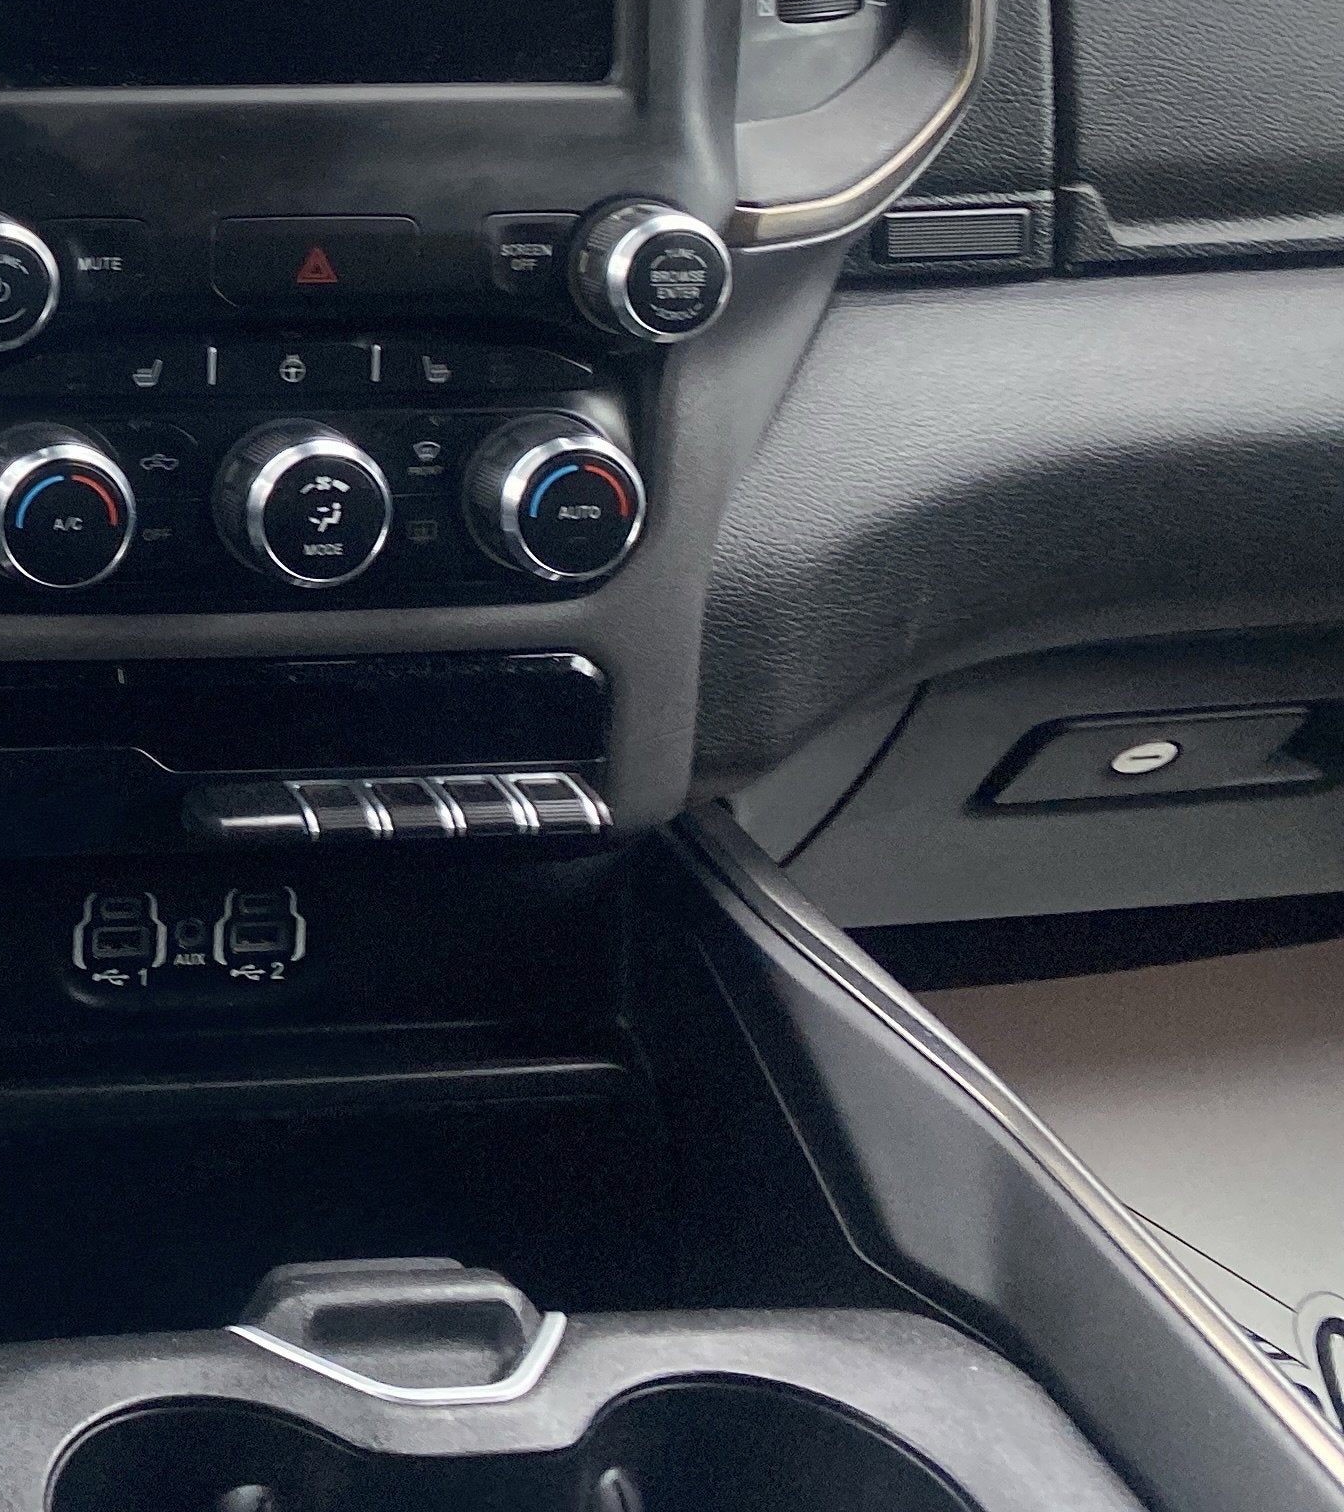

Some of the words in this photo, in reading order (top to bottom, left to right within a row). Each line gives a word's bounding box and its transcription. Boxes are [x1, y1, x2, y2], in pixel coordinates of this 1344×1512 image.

[500, 243, 553, 257] SCREEN
[77, 256, 124, 271] MUTE
[511, 258, 538, 271] OFF
[650, 269, 707, 283] BROWSE
[656, 287, 701, 300] ENTER
[557, 505, 602, 521] AUTO
[52, 516, 83, 532] A/C
[302, 543, 344, 556] MODE
[173, 952, 206, 966] AUX
[268, 961, 286, 981] 2
